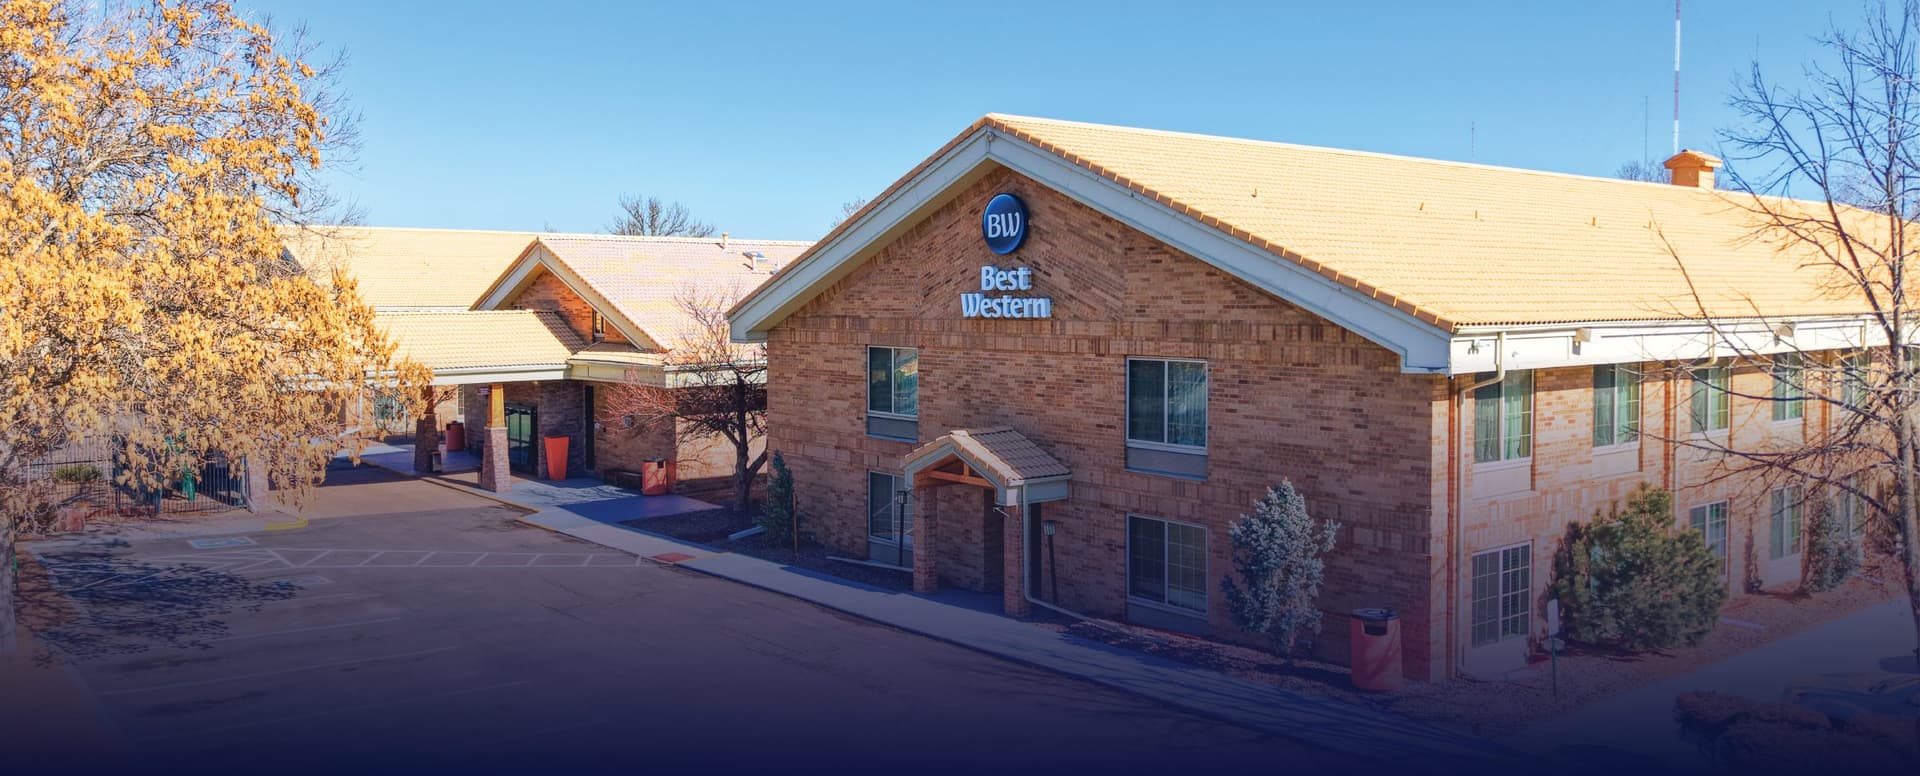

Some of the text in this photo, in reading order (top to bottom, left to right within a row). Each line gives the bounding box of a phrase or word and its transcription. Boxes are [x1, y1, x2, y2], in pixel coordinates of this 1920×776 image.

[988, 212, 1020, 238] BW
[981, 265, 1032, 291] Best
[960, 292, 1051, 318] Western
